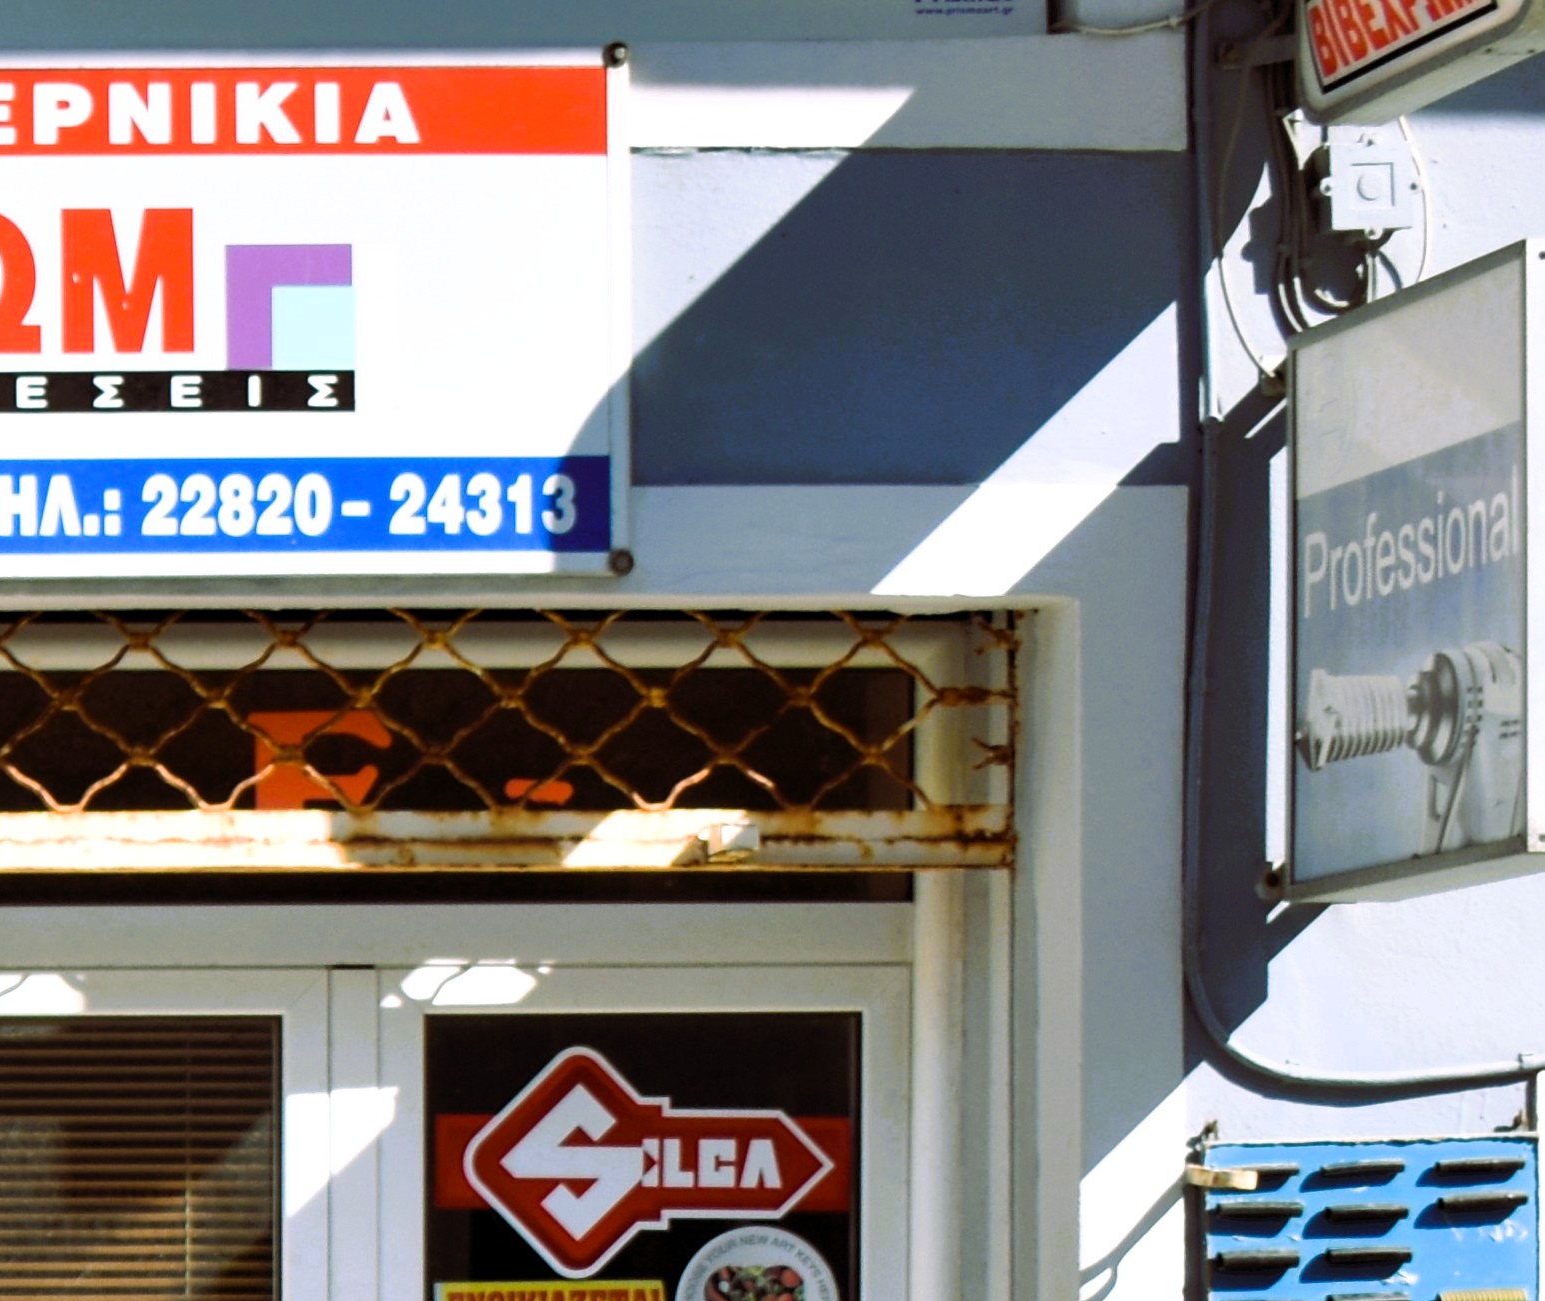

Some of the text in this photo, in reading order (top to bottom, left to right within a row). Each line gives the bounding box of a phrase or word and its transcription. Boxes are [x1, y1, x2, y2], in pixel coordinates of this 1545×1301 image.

[1307, 0, 1479, 78] ΒΙΒΕΧΡ
[143, 470, 333, 538] 22820
[390, 468, 579, 536] 24313
[1304, 467, 1521, 617] Professional
[500, 1084, 782, 1241] SILCA
[738, 1234, 769, 1247] NEW
[770, 1235, 797, 1251] ART
